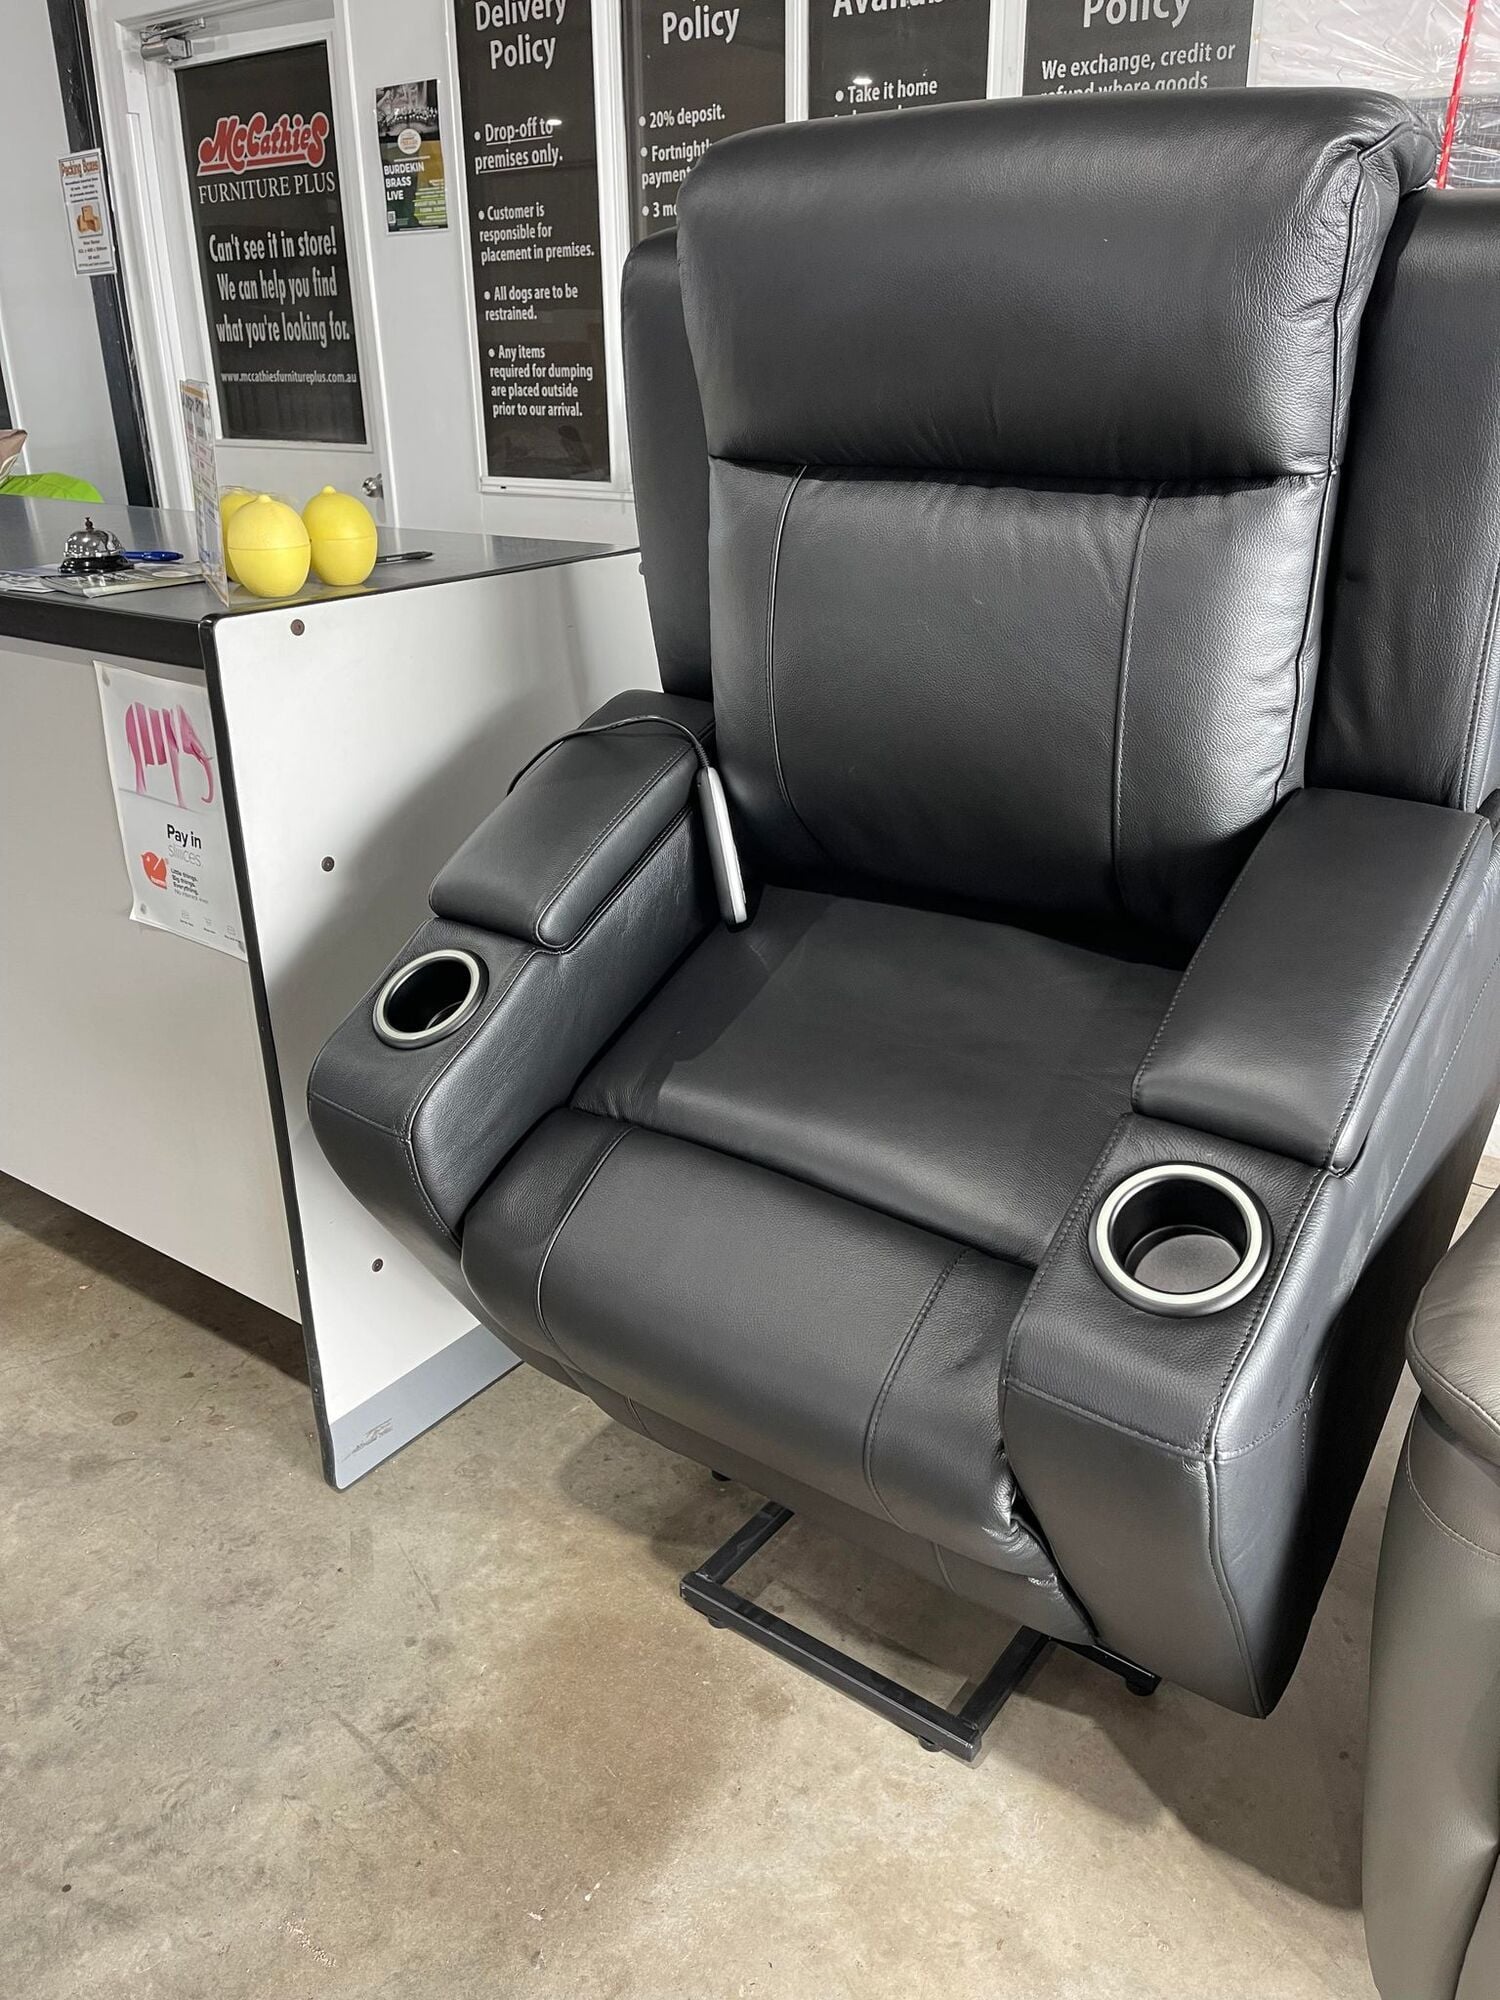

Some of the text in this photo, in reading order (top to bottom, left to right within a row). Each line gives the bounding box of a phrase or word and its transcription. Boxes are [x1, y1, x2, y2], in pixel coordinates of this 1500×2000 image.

[475, 0, 566, 31] Delivery
[662, 5, 740, 44] Policy
[490, 34, 556, 69] Policy
[1041, 42, 1236, 80] We exchange, credit or
[848, 79, 938, 104] Take it home
[649, 103, 726, 129] 20% deposit.
[485, 116, 554, 144] Drop-off to
[475, 143, 564, 175] premises only.
[651, 138, 713, 163] Fortnightl
[384, 161, 425, 176] BURDEKIN
[198, 171, 336, 204] FURNITURE PLUS
[385, 176, 412, 189] BRASS
[387, 190, 404, 201] LIVE
[487, 202, 545, 221] Customer is
[652, 201, 660, 218] 3
[209, 225, 337, 262] Can't see it in store!
[479, 222, 553, 245] responsible for
[481, 241, 595, 266] placement in premises.
[216, 266, 338, 305] We can help you find
[494, 282, 579, 304] All dogs are to be
[485, 304, 538, 321] restrained.
[216, 310, 350, 348] what you're looking for.
[498, 344, 546, 362] Any items
[220, 370, 358, 385] www.mccathiesfurnitureplus.com.au
[490, 362, 593, 381] required for dumping
[491, 382, 579, 400] are placed outside
[492, 401, 583, 418] prior to our arrival.
[167, 823, 202, 849] Pay in
